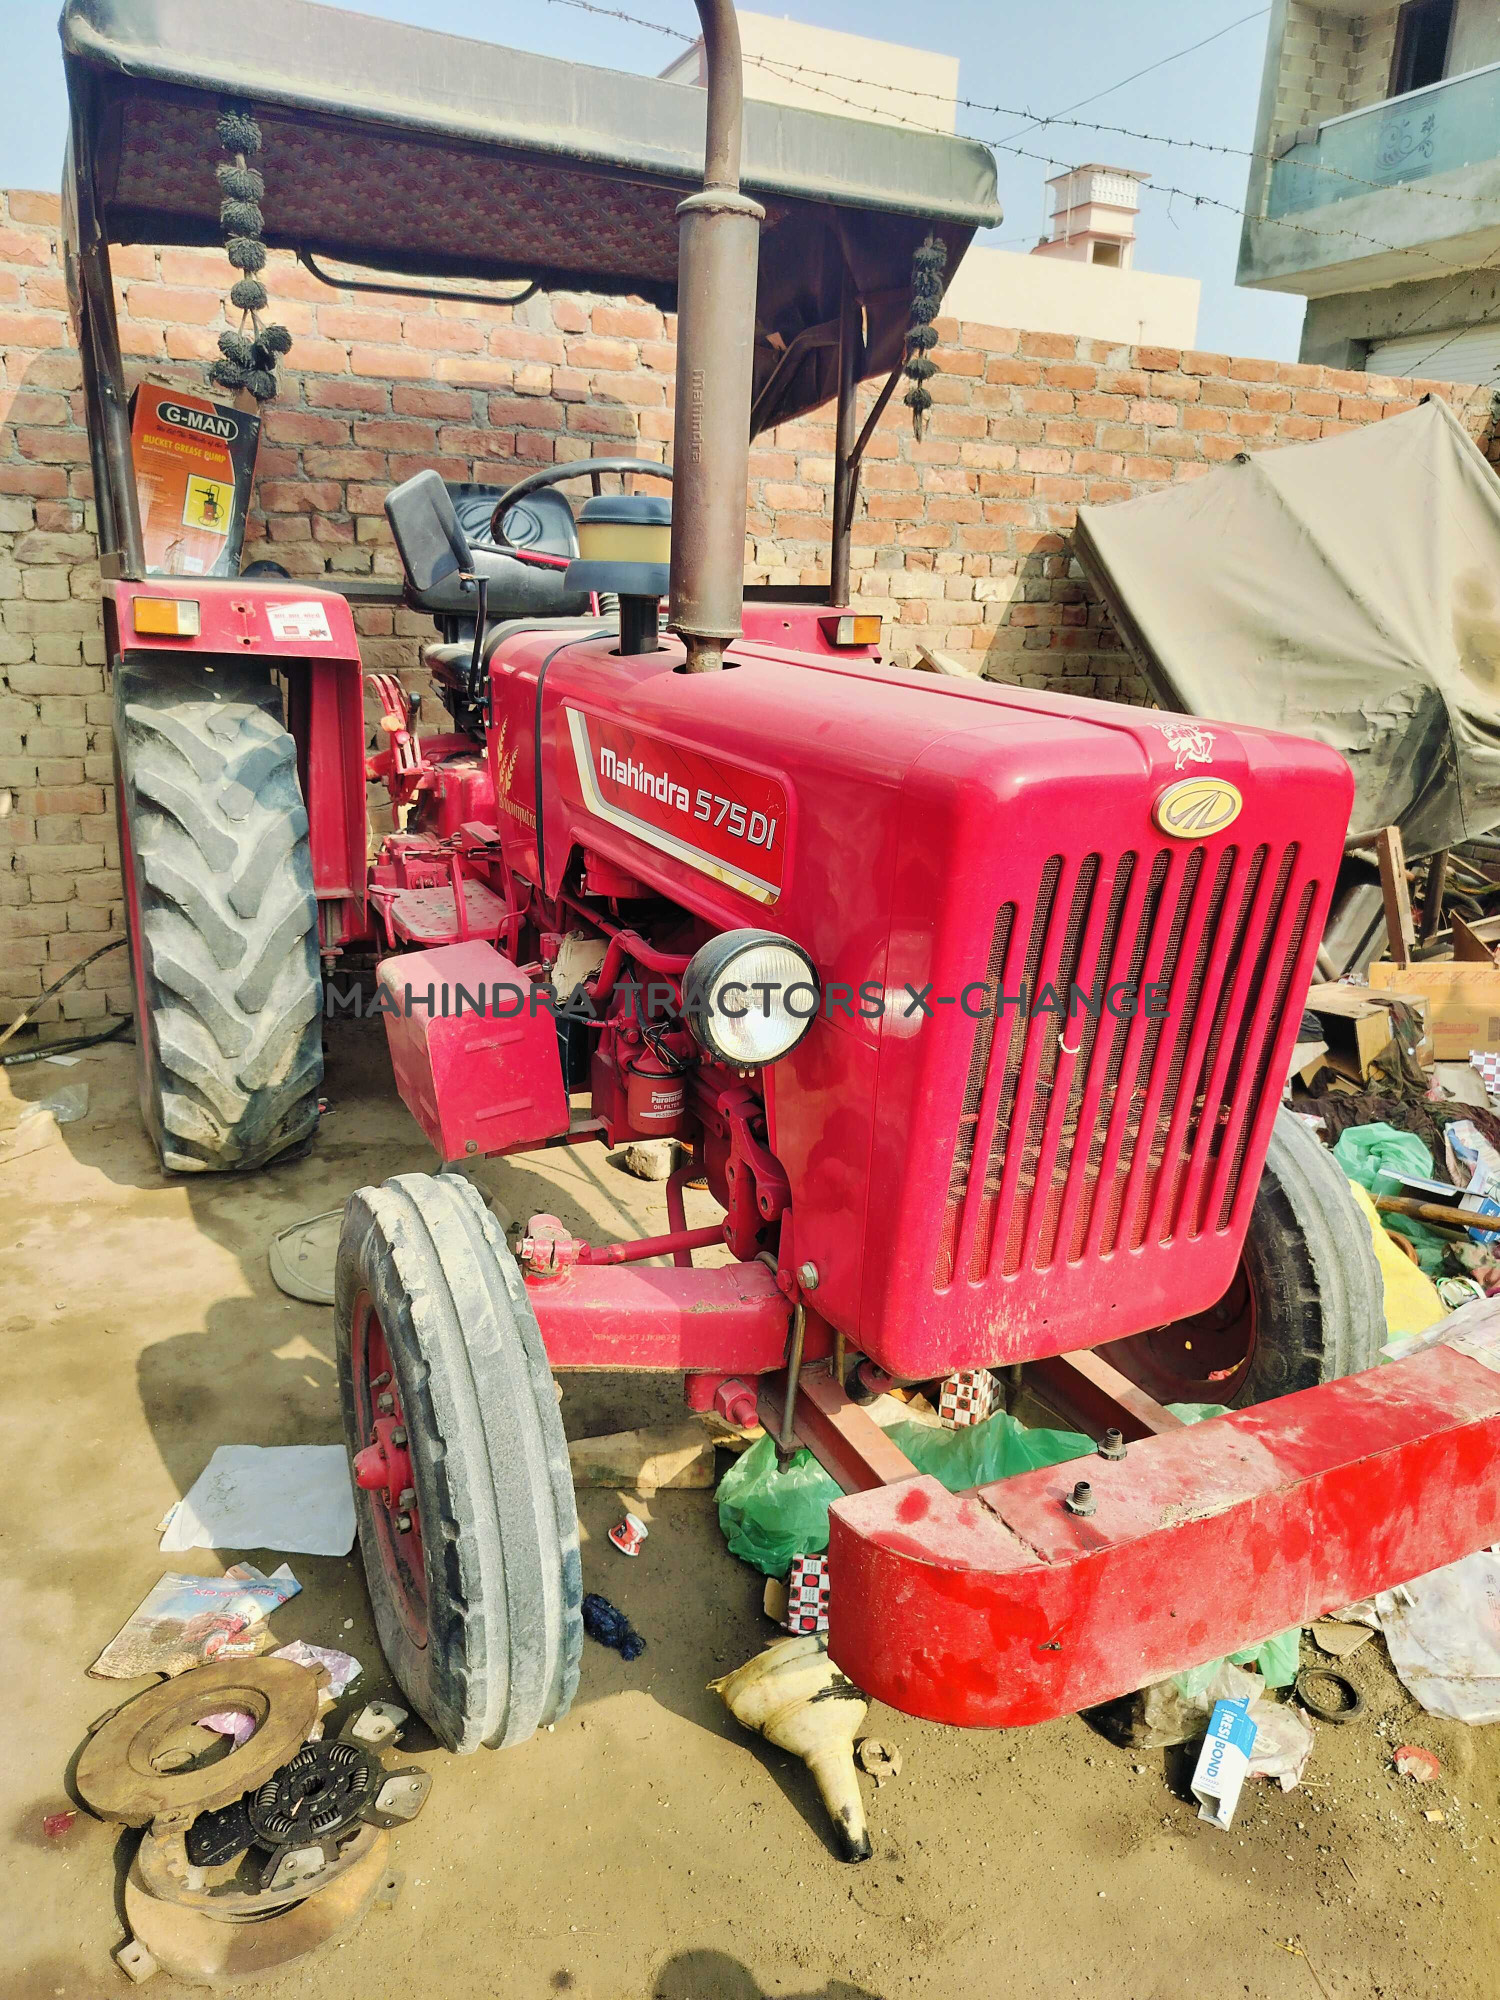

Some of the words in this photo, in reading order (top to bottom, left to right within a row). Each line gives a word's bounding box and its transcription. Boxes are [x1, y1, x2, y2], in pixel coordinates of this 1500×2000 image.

[166, 406, 230, 437] G-MAN
[143, 434, 173, 449] BUCKET
[174, 442, 203, 458] GREASE
[600, 746, 690, 813] Mahindra
